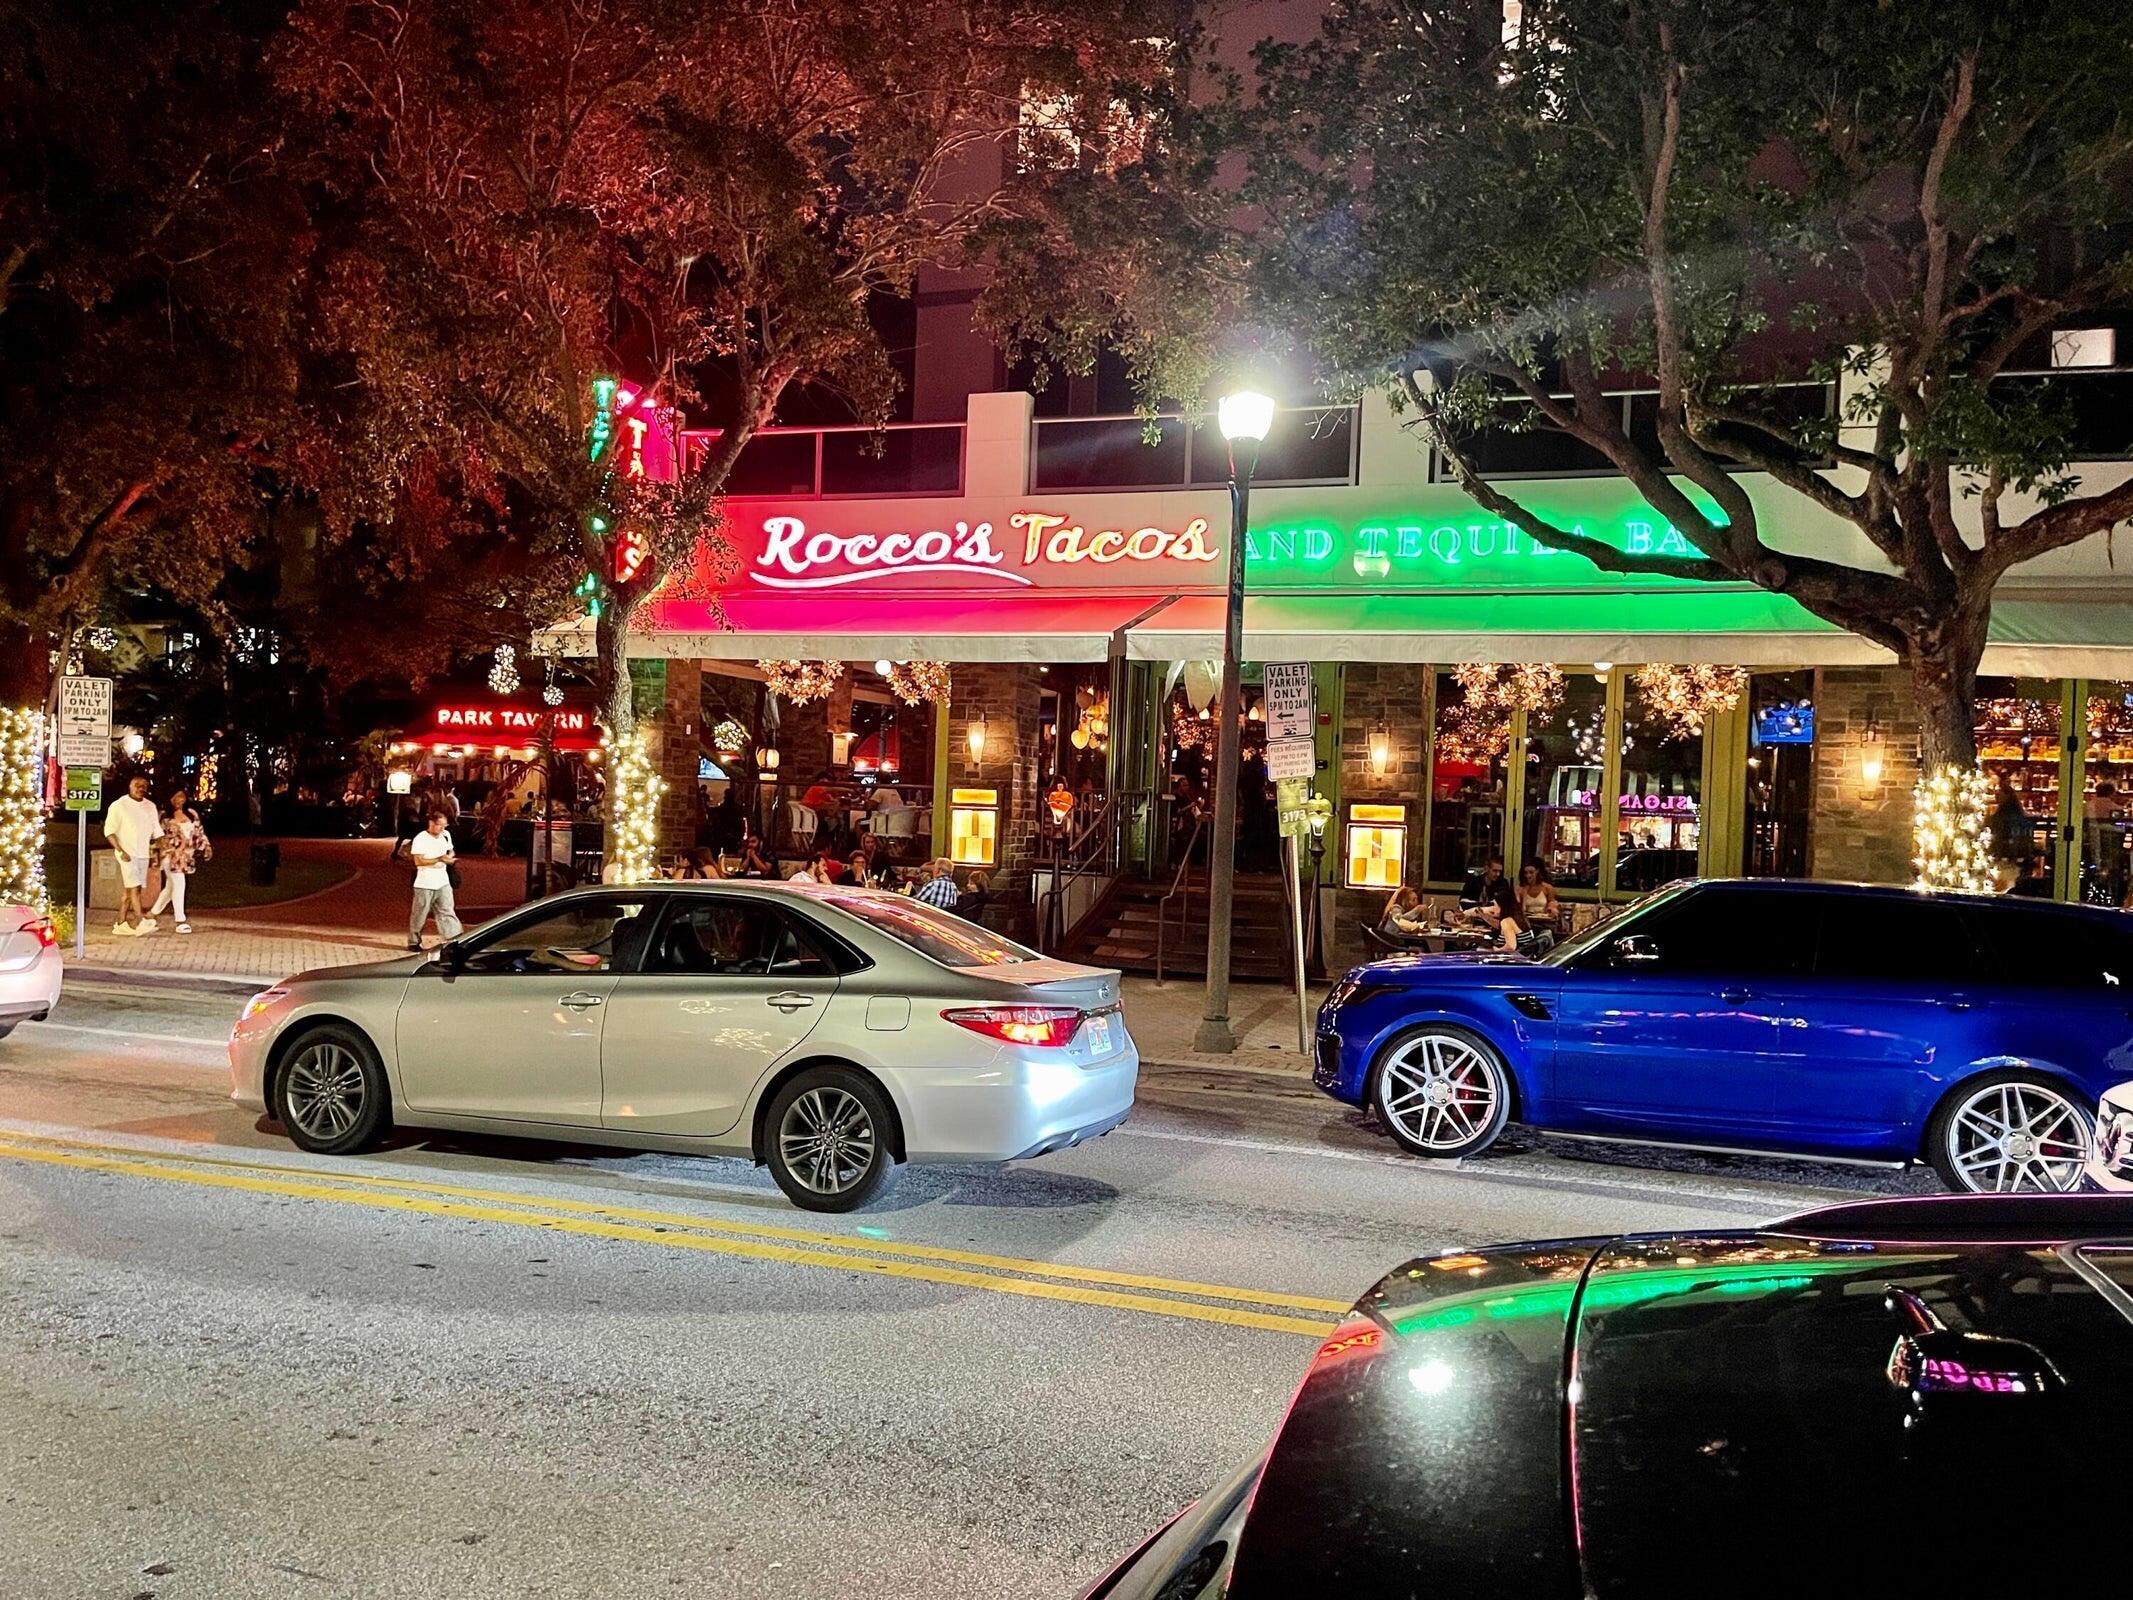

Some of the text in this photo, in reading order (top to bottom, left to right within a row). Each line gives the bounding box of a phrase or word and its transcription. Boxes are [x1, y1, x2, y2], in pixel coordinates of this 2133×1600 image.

[756, 516, 1003, 573] Rocco's
[1009, 511, 1220, 565] Tacos
[1359, 522, 1586, 564] TEQUI
[1625, 521, 1715, 554] BA
[1269, 666, 1305, 677] VALET
[66, 681, 107, 690] VALET
[1269, 677, 1306, 688] PARKING
[65, 690, 107, 698] PARKING
[1274, 688, 1302, 698] ONLY
[70, 698, 101, 706] ONLY
[1284, 700, 1294, 710] TO
[1295, 699, 1308, 709] 2AM
[81, 707, 91, 716] TO
[437, 709, 583, 729] PARK TAVRN
[69, 790, 98, 799] 3173
[1281, 809, 1306, 823] 3173
